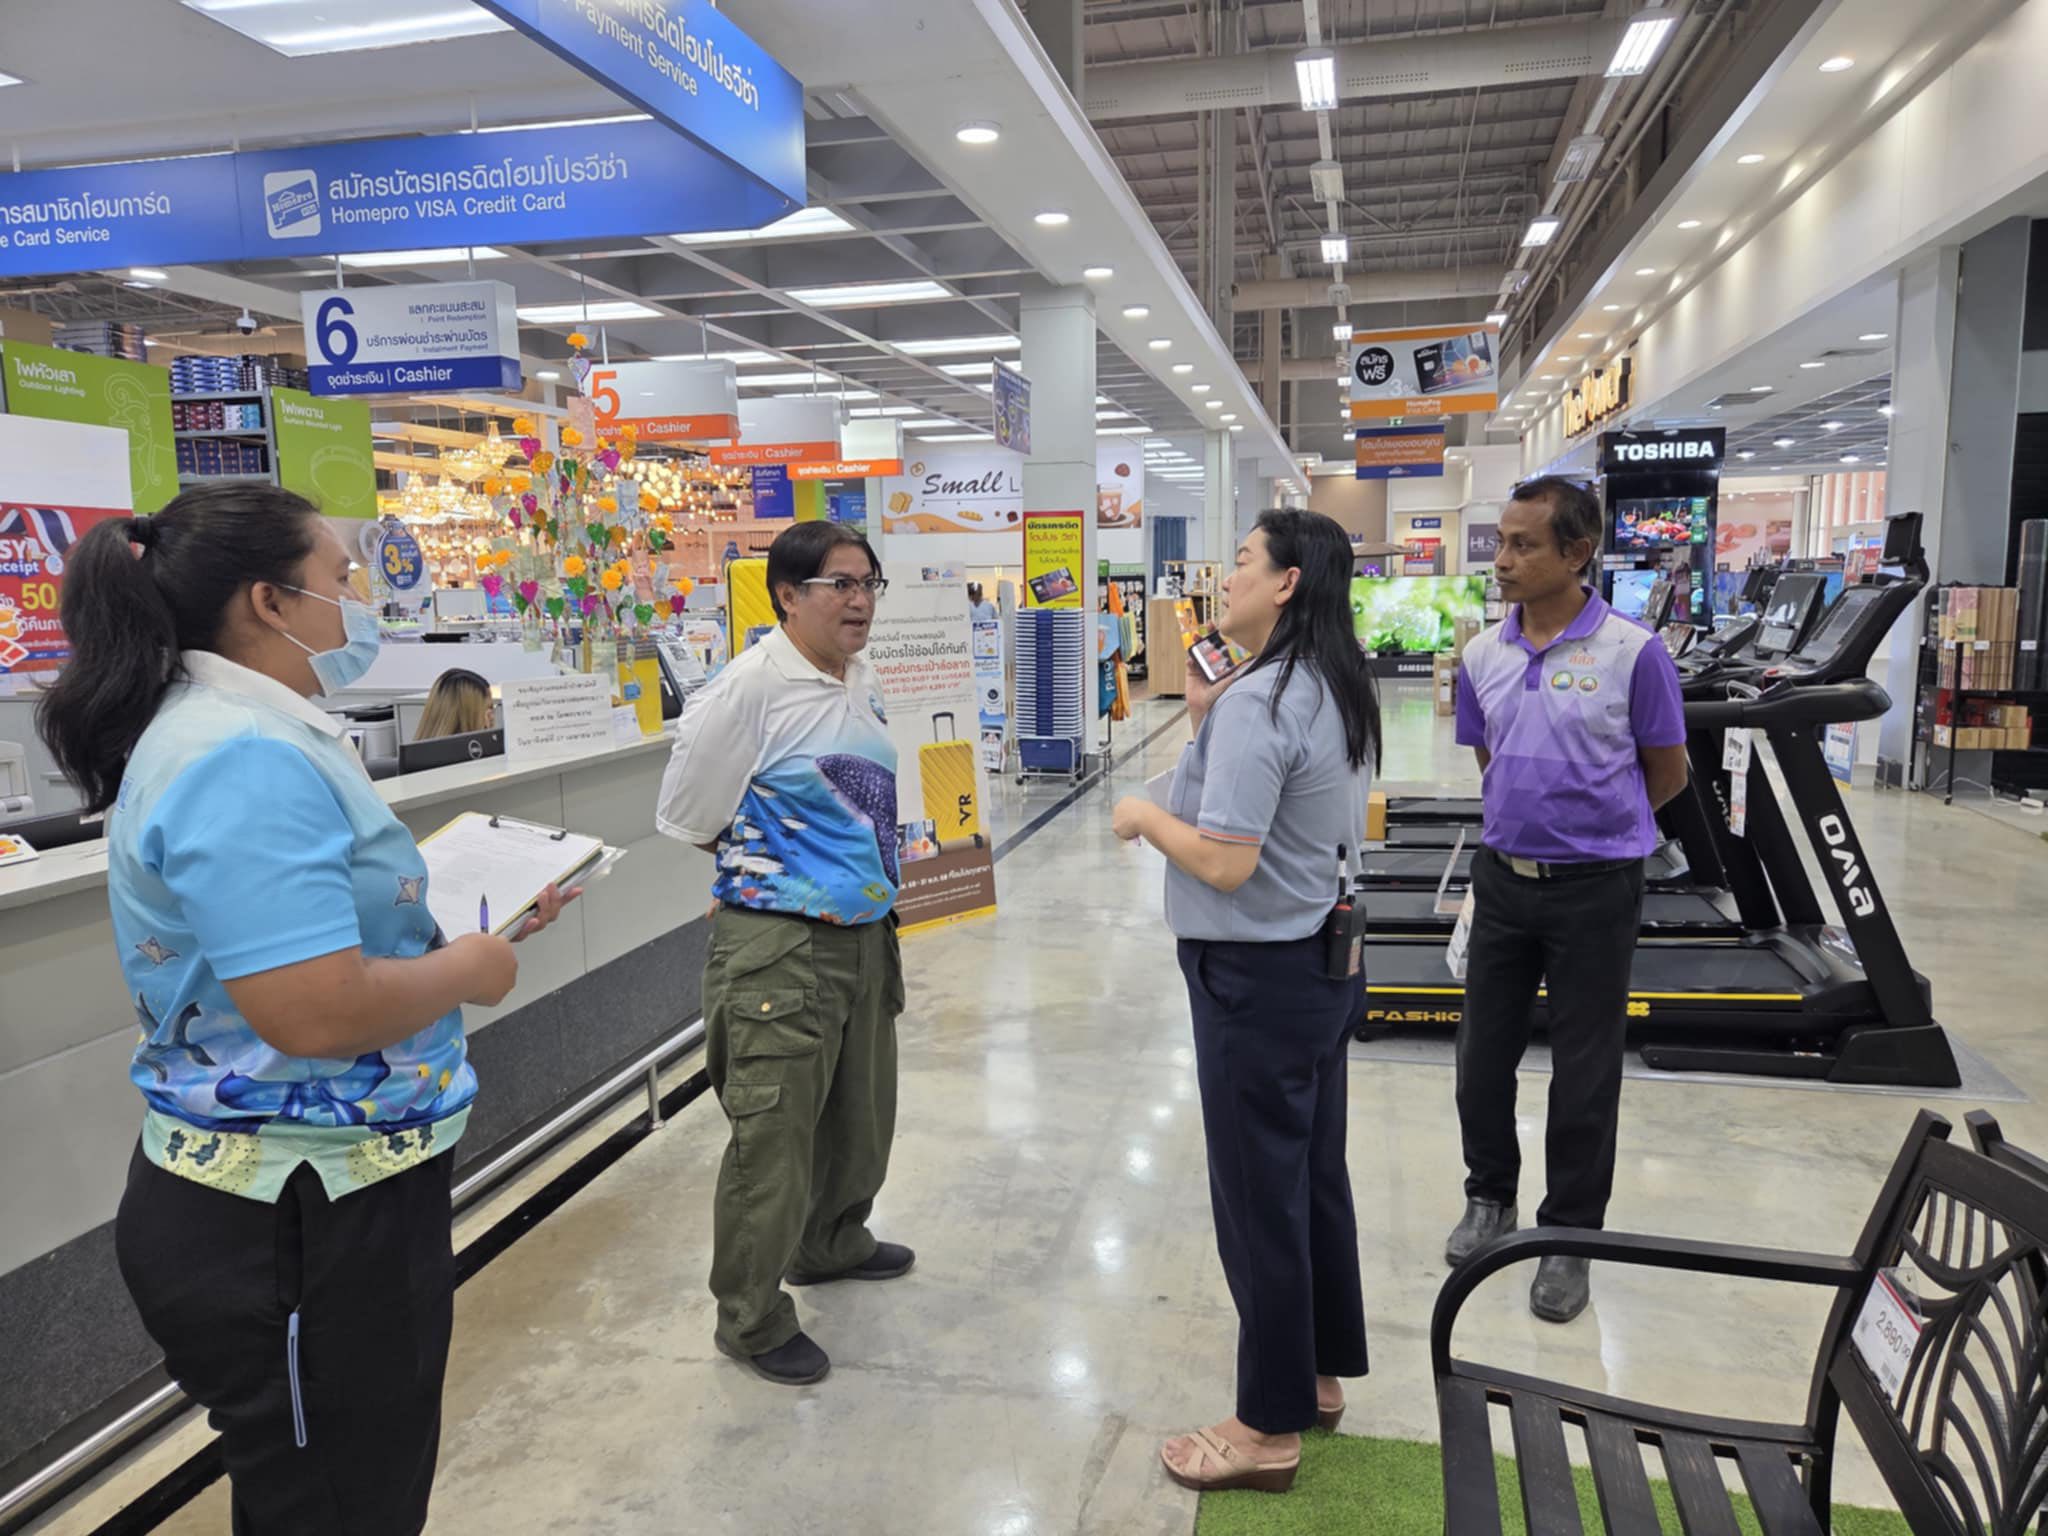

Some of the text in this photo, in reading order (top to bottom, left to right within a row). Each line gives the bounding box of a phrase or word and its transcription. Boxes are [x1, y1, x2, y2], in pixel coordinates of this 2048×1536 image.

[614, 0, 759, 111] ครดิตโฮมโปรวีซ่า
[648, 41, 698, 96] Service
[329, 152, 628, 199] สมัครบัตรเครดิตโฮมโปรวีซ่า
[0, 191, 171, 224] ารสมาชิกโฮมการ์ด
[331, 205, 410, 225] Homepro
[415, 198, 458, 218] VISA
[463, 195, 517, 215] Credit
[522, 191, 566, 211] Card
[13, 229, 50, 247] Card
[56, 226, 110, 244] Service
[316, 297, 359, 366] 6
[1360, 353, 1388, 366] สมัคร
[327, 369, 384, 389] จุดชำระเงิน
[394, 366, 453, 384] Cashier
[1363, 364, 1386, 381] ฟรี
[592, 371, 621, 420] 5
[647, 422, 692, 434] Cashier
[765, 448, 803, 459] Cashier
[1614, 441, 1715, 461] TOSHIBA
[836, 463, 871, 474] Cashier
[922, 471, 1024, 495] Small L
[1397, 664, 1434, 672] SAMSUN
[958, 793, 972, 826] VR
